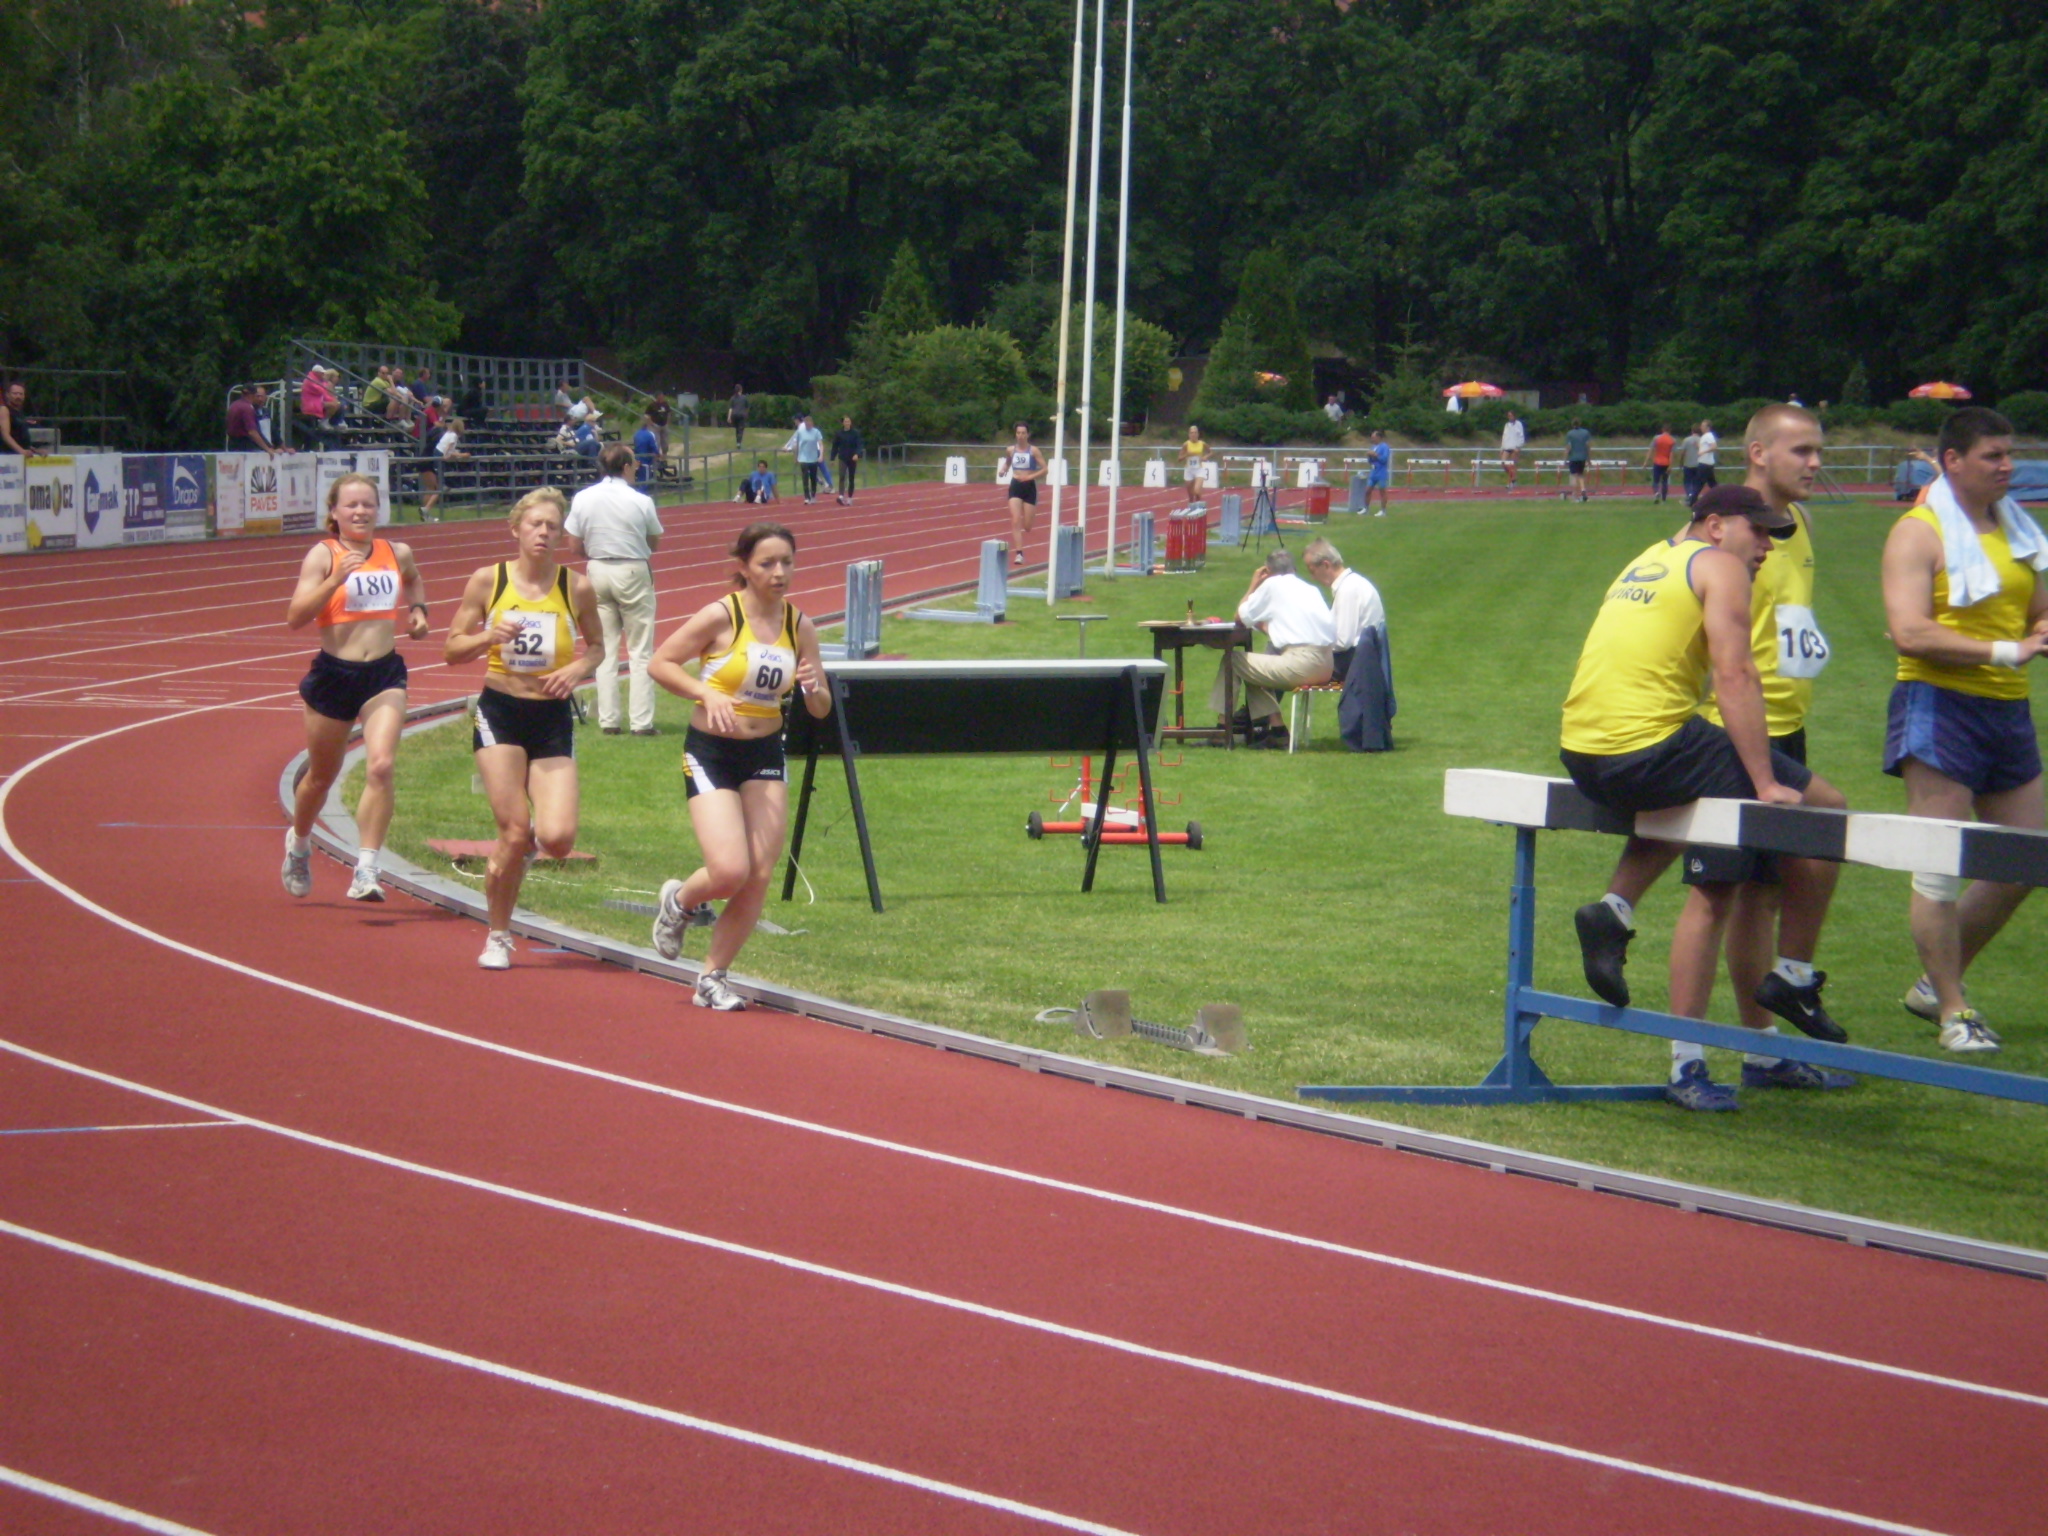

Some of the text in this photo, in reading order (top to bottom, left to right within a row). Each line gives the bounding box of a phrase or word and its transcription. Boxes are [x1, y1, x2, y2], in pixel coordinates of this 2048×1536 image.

[952, 463, 958, 477] 8
[1151, 467, 1157, 481] 4
[1305, 468, 1311, 482] 1
[250, 496, 278, 512] PAVES
[354, 574, 393, 596] 180
[513, 633, 543, 656] 52
[1781, 627, 1827, 660] 103
[755, 664, 784, 691] 60
